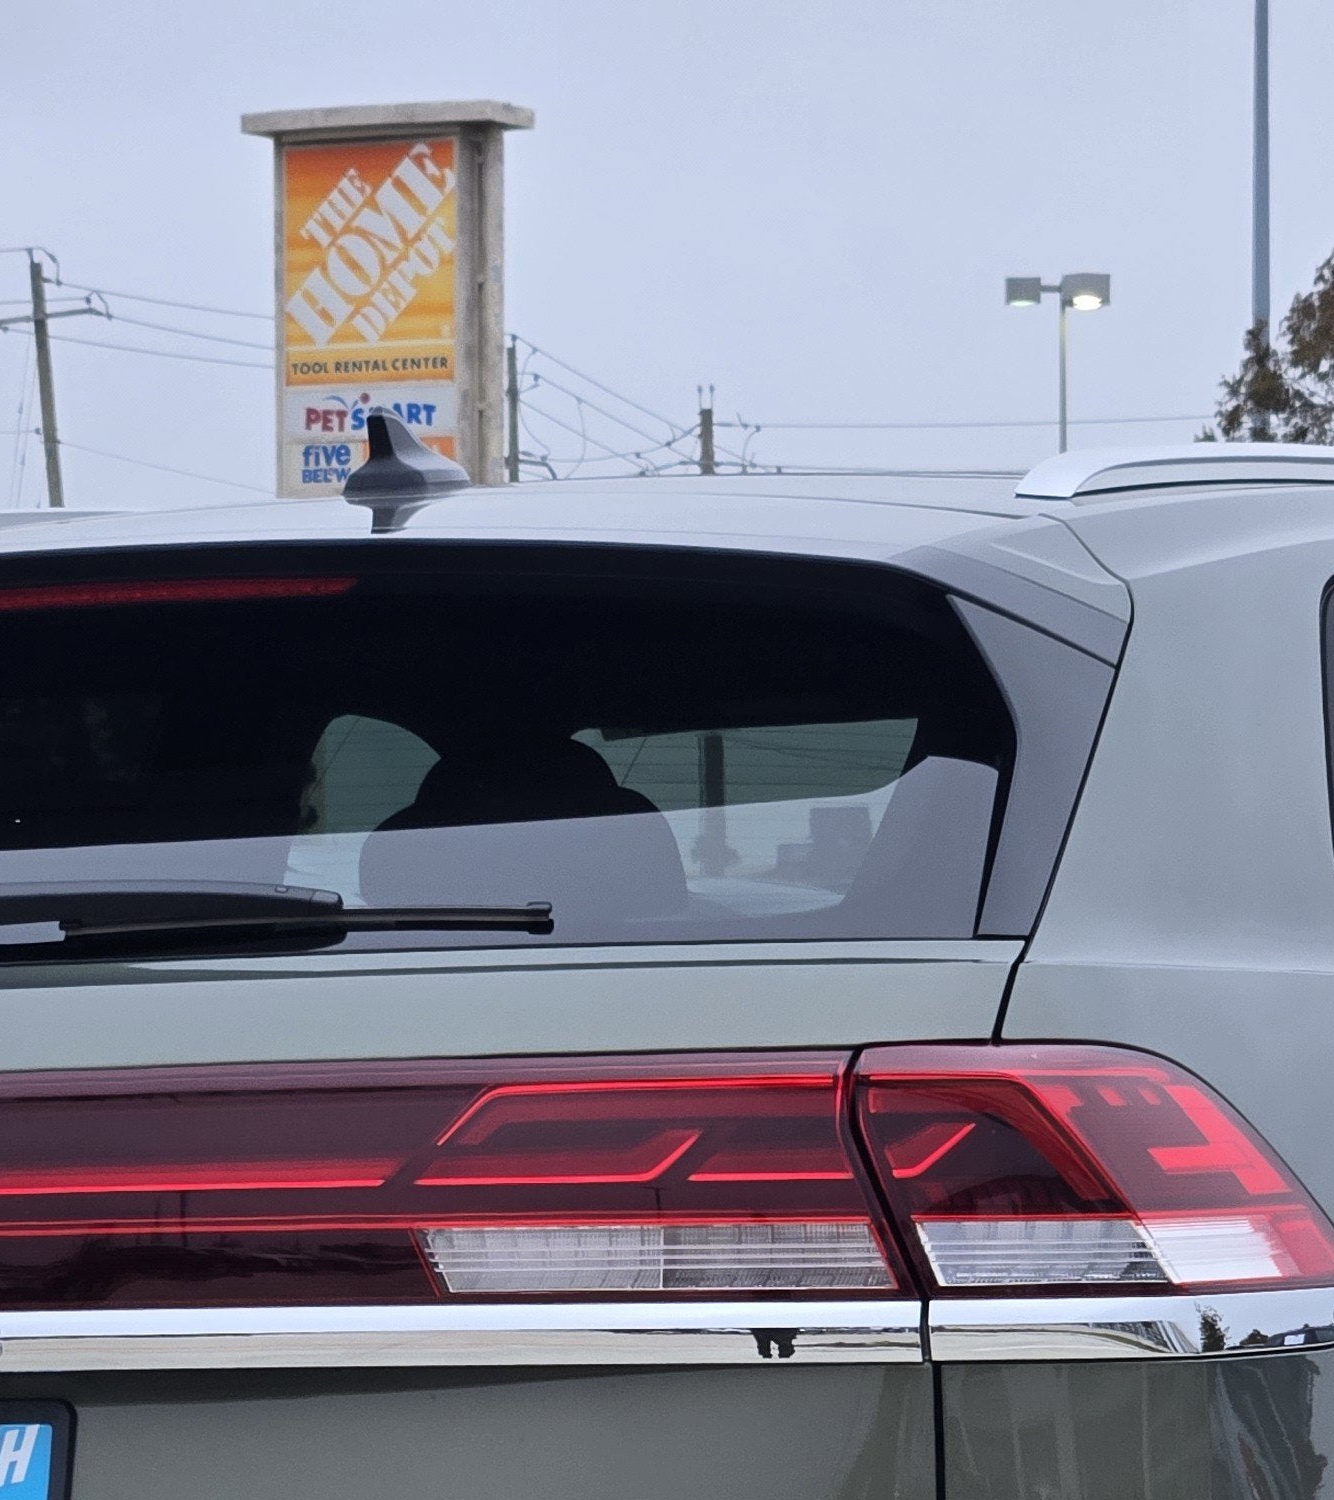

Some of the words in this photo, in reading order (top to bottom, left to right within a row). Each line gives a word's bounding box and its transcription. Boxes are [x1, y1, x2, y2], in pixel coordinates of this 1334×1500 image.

[299, 167, 372, 249] THE
[286, 143, 457, 348] HOME
[352, 217, 457, 347] DEPOT
[291, 362, 329, 376] TOOL
[334, 359, 388, 374] RENTAL
[392, 356, 449, 371] CENTER
[305, 403, 436, 432] PETSRT
[302, 444, 351, 466] five
